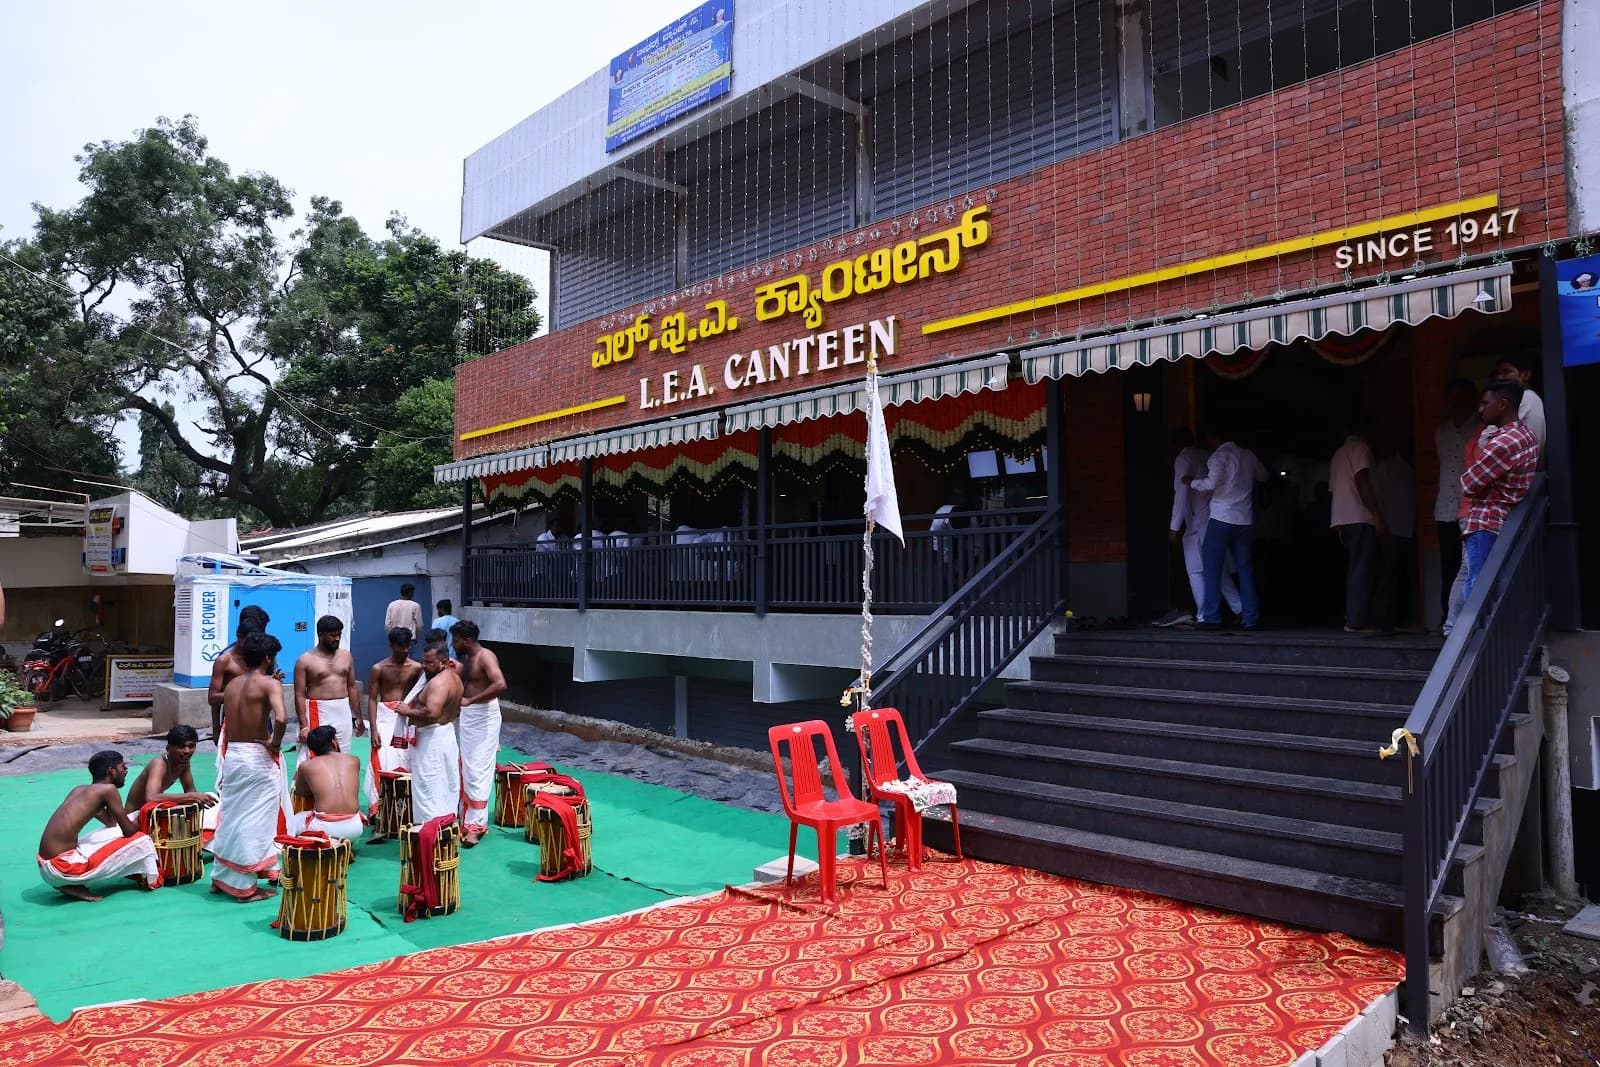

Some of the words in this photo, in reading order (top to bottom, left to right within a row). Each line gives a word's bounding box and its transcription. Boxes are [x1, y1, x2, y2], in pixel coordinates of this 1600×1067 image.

[754, 204, 990, 330] ಕ್ಯಾಂಟೀನ್
[1335, 227, 1433, 269] SINCE
[1444, 208, 1520, 246] 1947
[639, 364, 714, 410] L.E.A.
[723, 315, 898, 391] CANTEEN
[201, 591, 216, 625] POWER
[201, 627, 216, 640] GK
